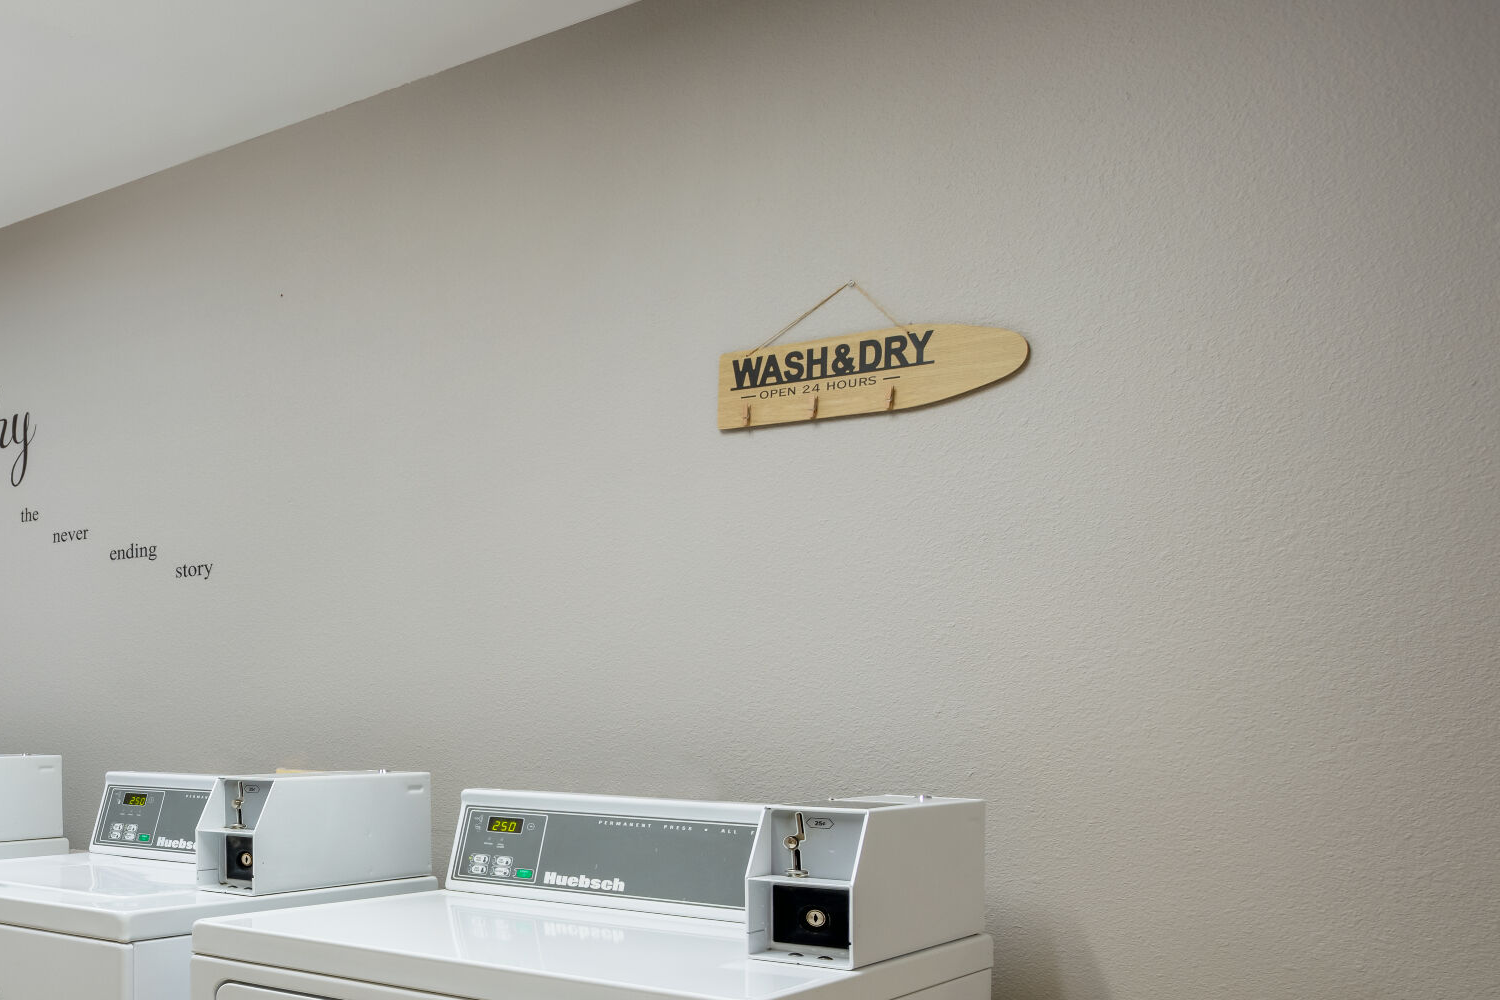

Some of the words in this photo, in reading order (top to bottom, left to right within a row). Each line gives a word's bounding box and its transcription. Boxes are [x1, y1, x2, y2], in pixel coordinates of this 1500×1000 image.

[732, 330, 934, 390] WASH&DRY
[759, 386, 797, 400] OPEN
[802, 383, 821, 395] 24
[826, 376, 877, 391] HOURS
[20, 508, 39, 523] the
[52, 528, 89, 544] never
[109, 542, 158, 561] ending
[175, 562, 214, 580] story
[129, 796, 146, 806] 250
[492, 820, 517, 832] 250
[543, 871, 625, 892] Huebsch
